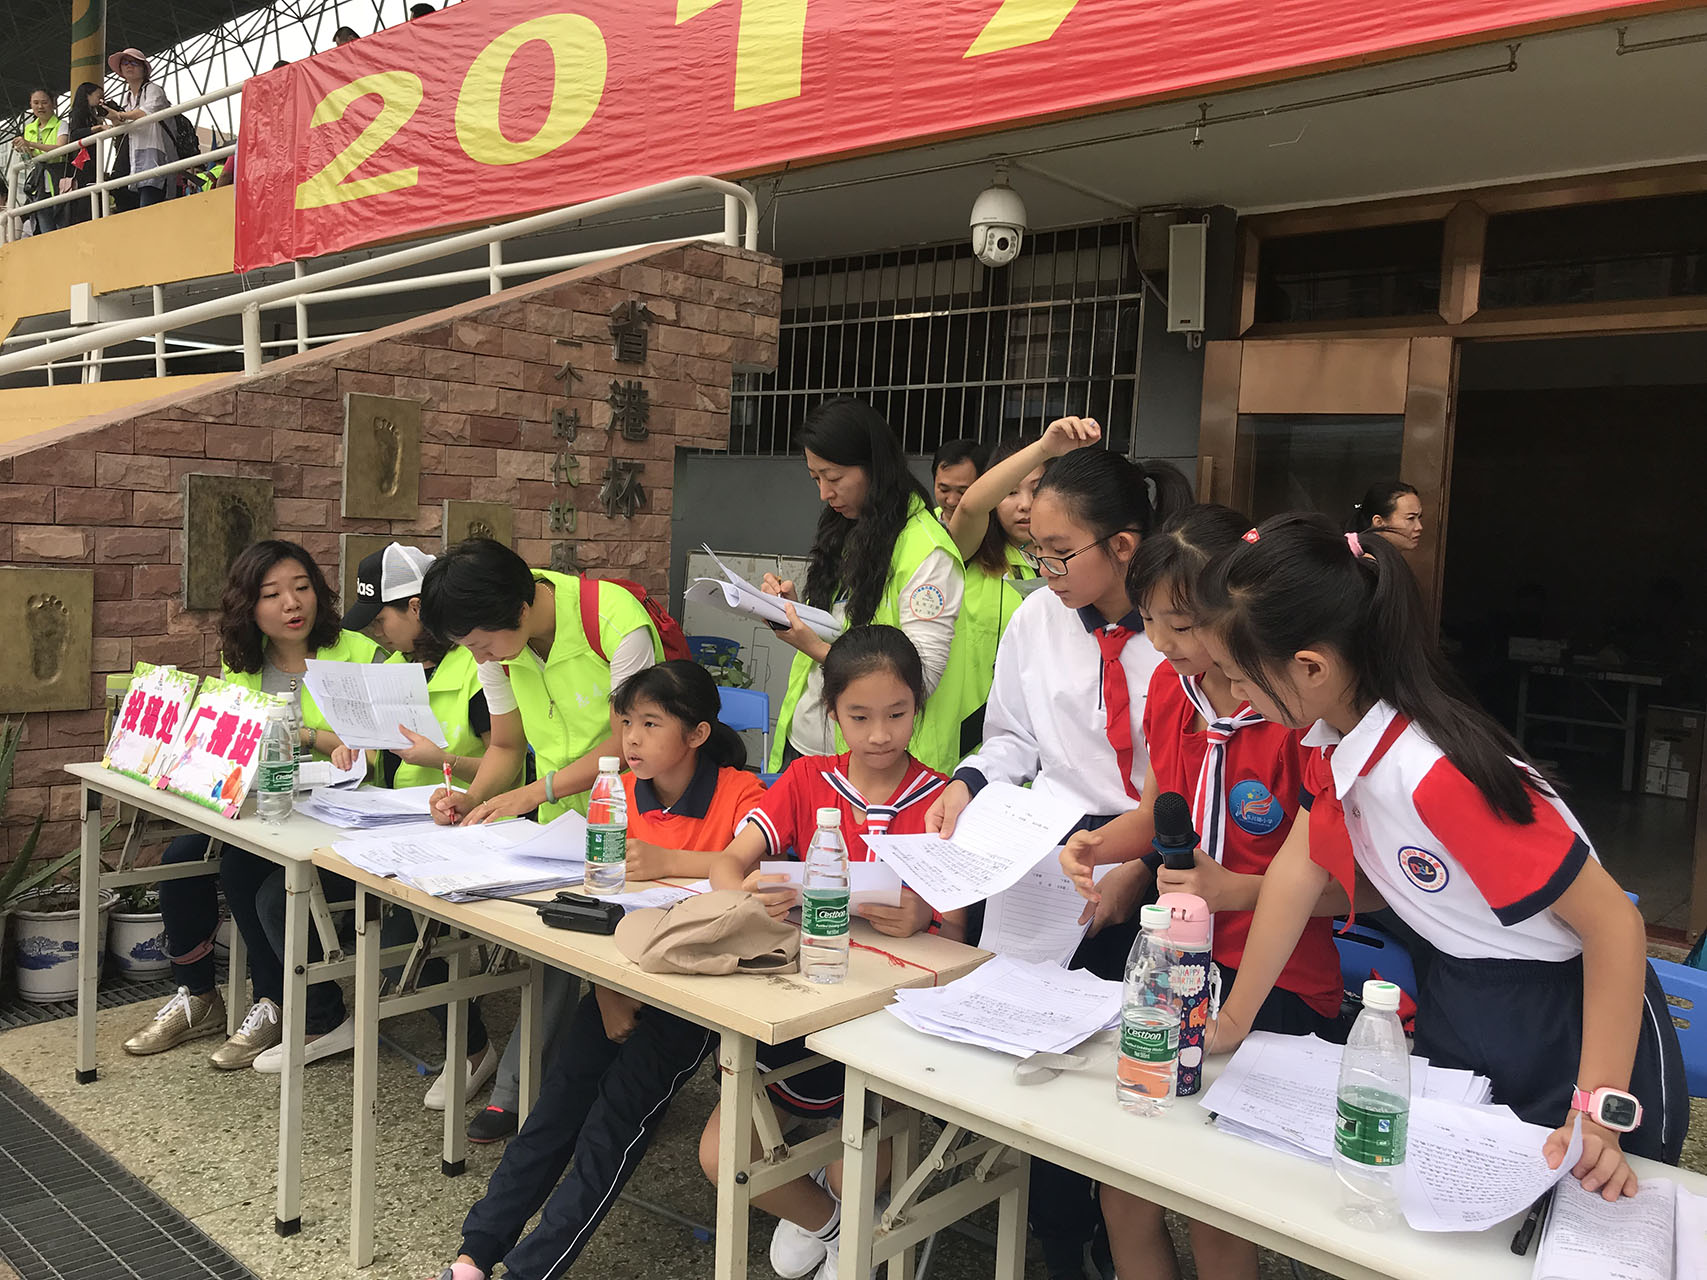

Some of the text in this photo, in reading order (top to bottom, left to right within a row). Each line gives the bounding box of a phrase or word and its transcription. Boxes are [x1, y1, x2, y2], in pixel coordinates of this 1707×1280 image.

[600, 300, 653, 519] 省港杯
[121, 689, 180, 744] 投稿处
[185, 706, 262, 767] 广播站
